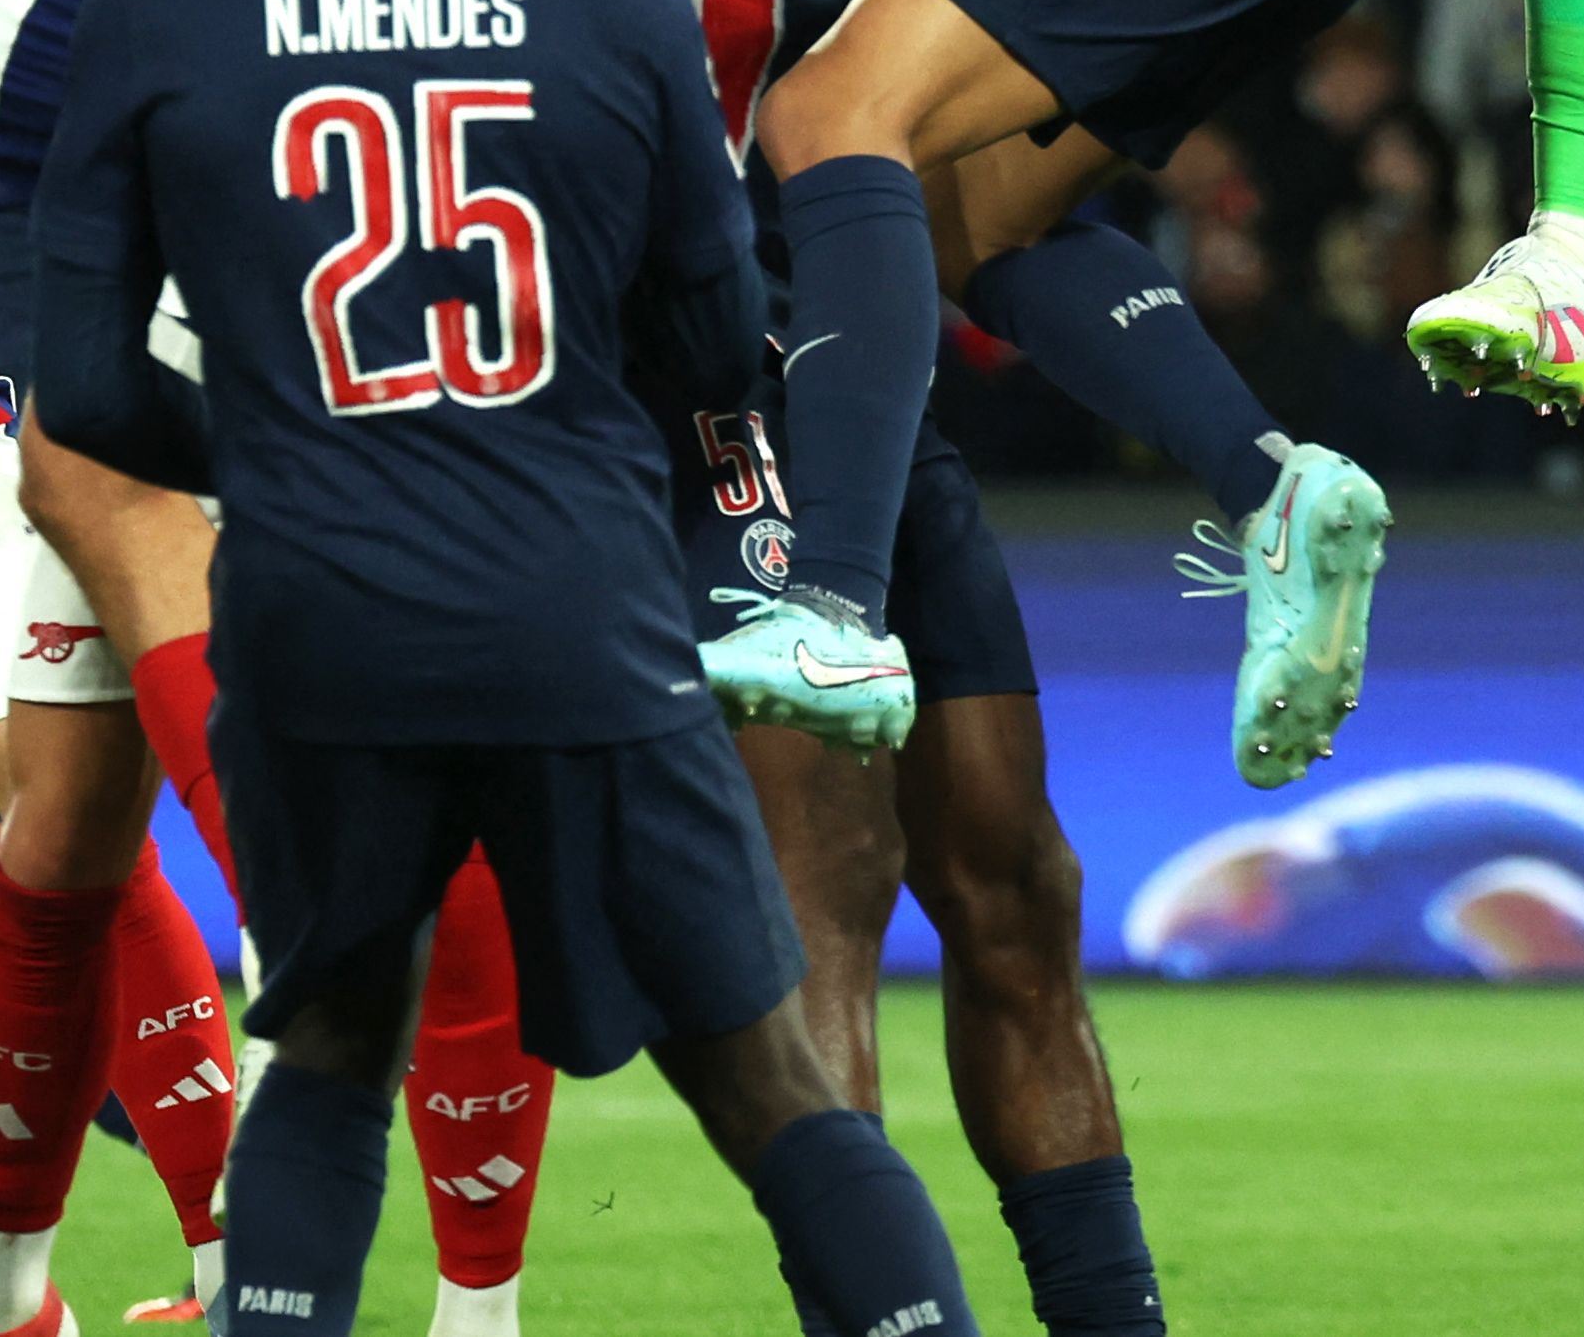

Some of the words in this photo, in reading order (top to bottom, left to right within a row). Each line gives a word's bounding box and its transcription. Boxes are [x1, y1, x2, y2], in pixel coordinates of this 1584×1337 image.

[272, 79, 556, 418] 25
[137, 995, 216, 1041] AFC
[425, 1082, 531, 1122] AFC
[237, 1284, 314, 1320] PARIS
